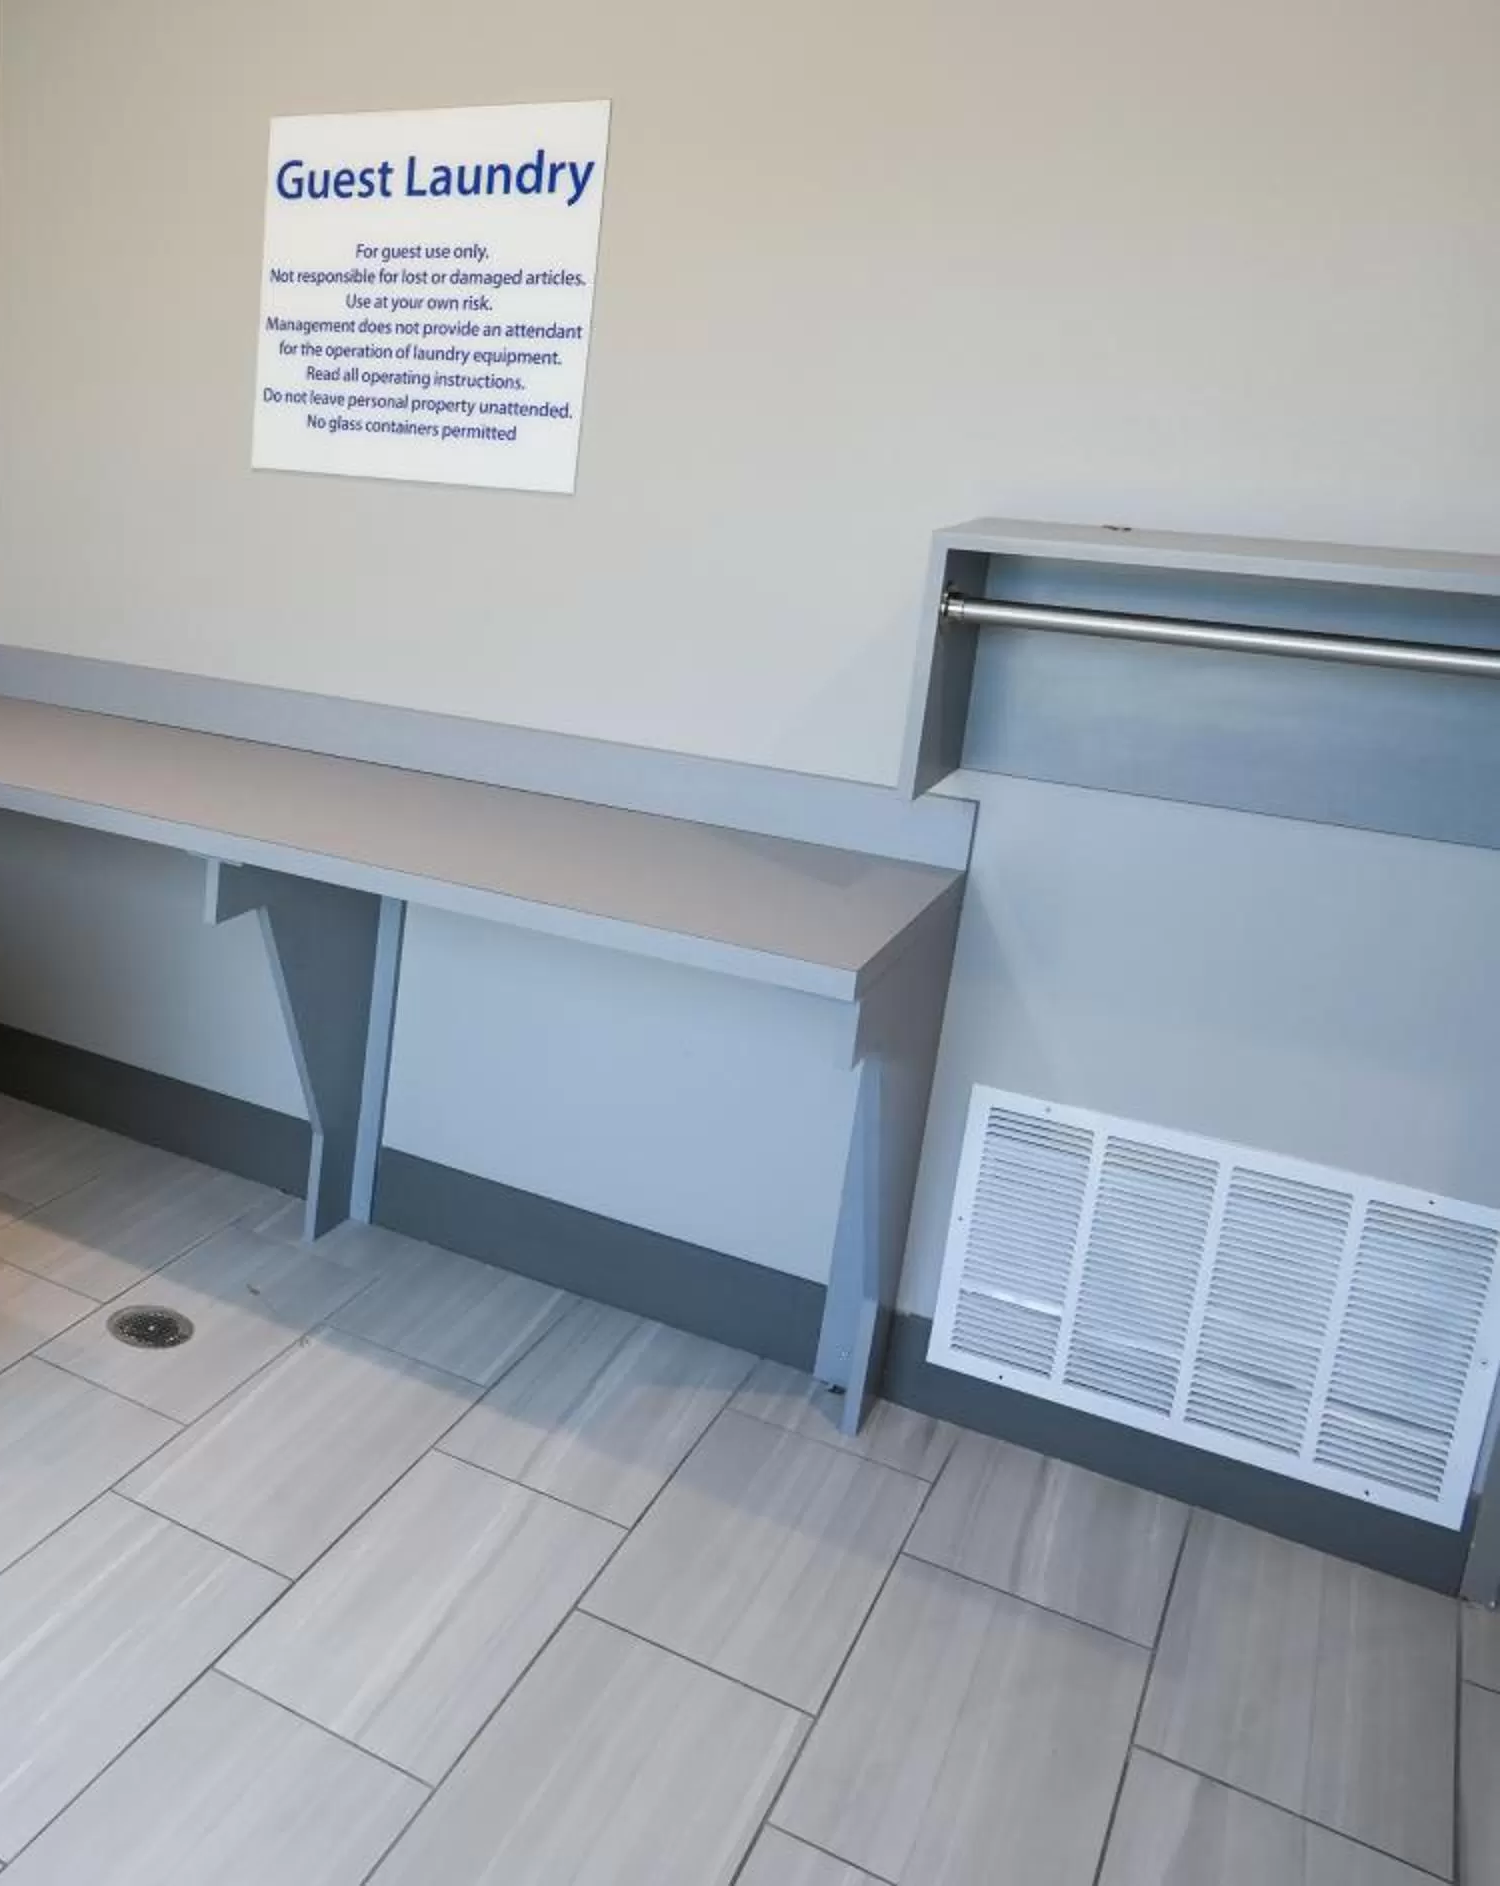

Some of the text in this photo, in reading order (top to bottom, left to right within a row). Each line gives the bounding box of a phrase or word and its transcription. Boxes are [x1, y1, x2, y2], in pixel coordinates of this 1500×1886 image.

[276, 148, 596, 207] Guest Laundry
[355, 243, 489, 264] For guest use only.
[269, 267, 587, 289] Not responsible for lost or damaged articles.
[345, 293, 493, 313] Use at your own risk.
[266, 316, 583, 340] Management does not provide an attendant
[279, 339, 562, 367] for the operation of laundry equipment.
[306, 365, 525, 391] Read all operating instructions.
[263, 387, 573, 419] Do not leave personal property unattended.
[307, 413, 517, 441] No glass containers permitted
